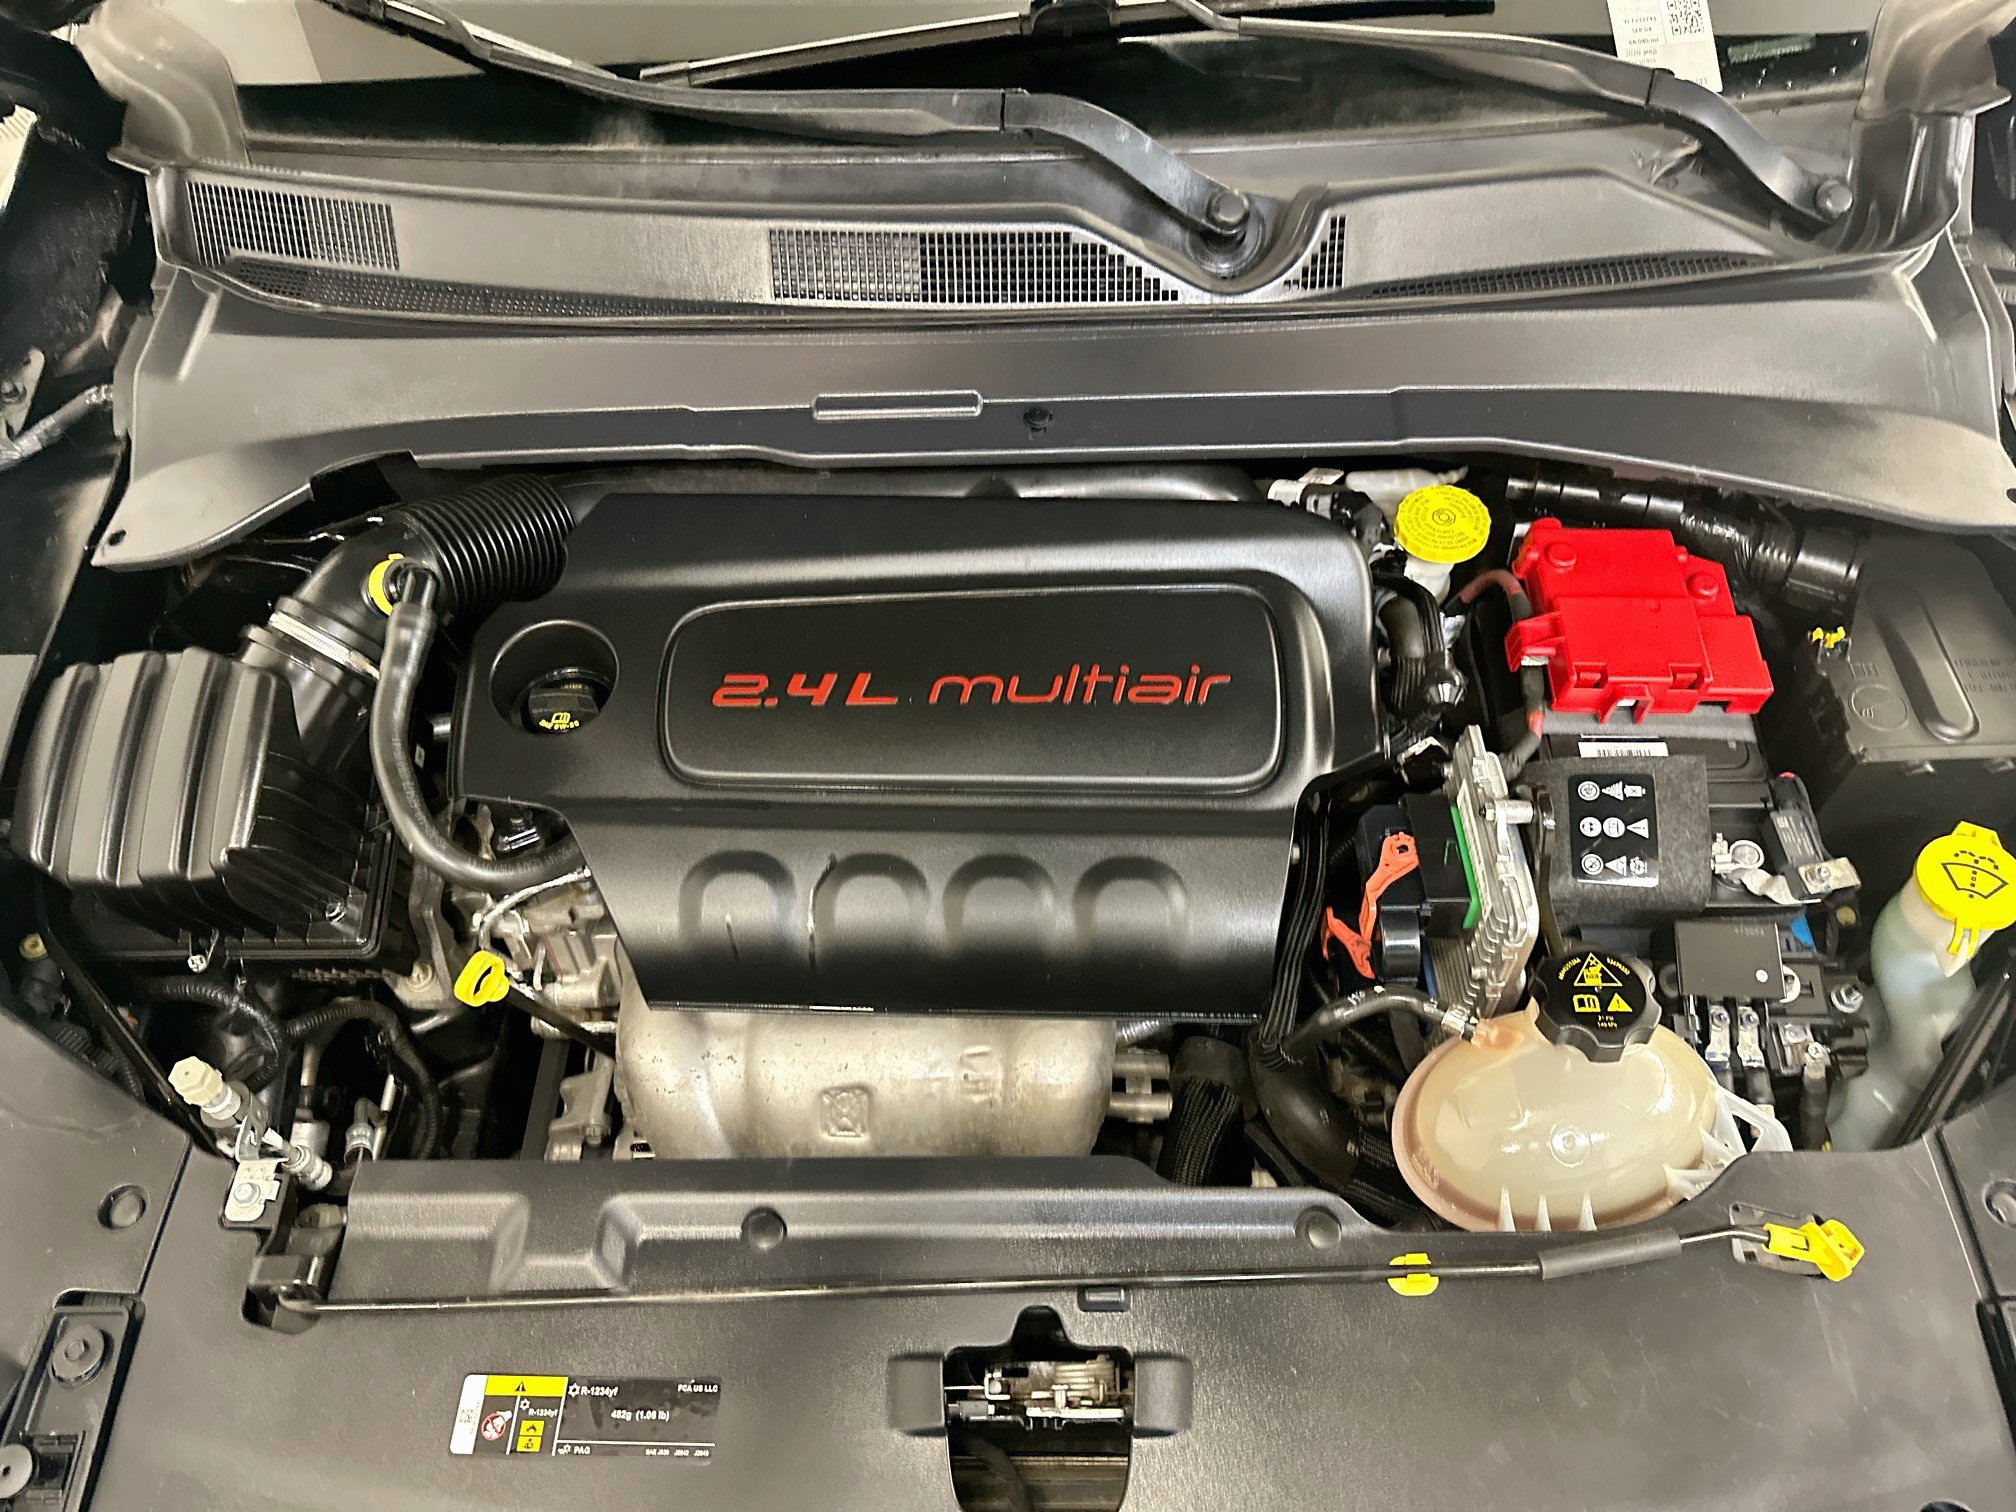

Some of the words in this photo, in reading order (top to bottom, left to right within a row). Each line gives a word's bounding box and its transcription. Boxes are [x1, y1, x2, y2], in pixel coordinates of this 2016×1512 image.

[928, 663, 1232, 706] multiair
[581, 1386, 619, 1398] R-1234yf
[677, 1384, 693, 1393] FCA
[704, 1384, 719, 1393] LLC
[528, 1408, 558, 1418] R-1234yf
[610, 1410, 632, 1422] 482g
[573, 1446, 591, 1455] PAG
